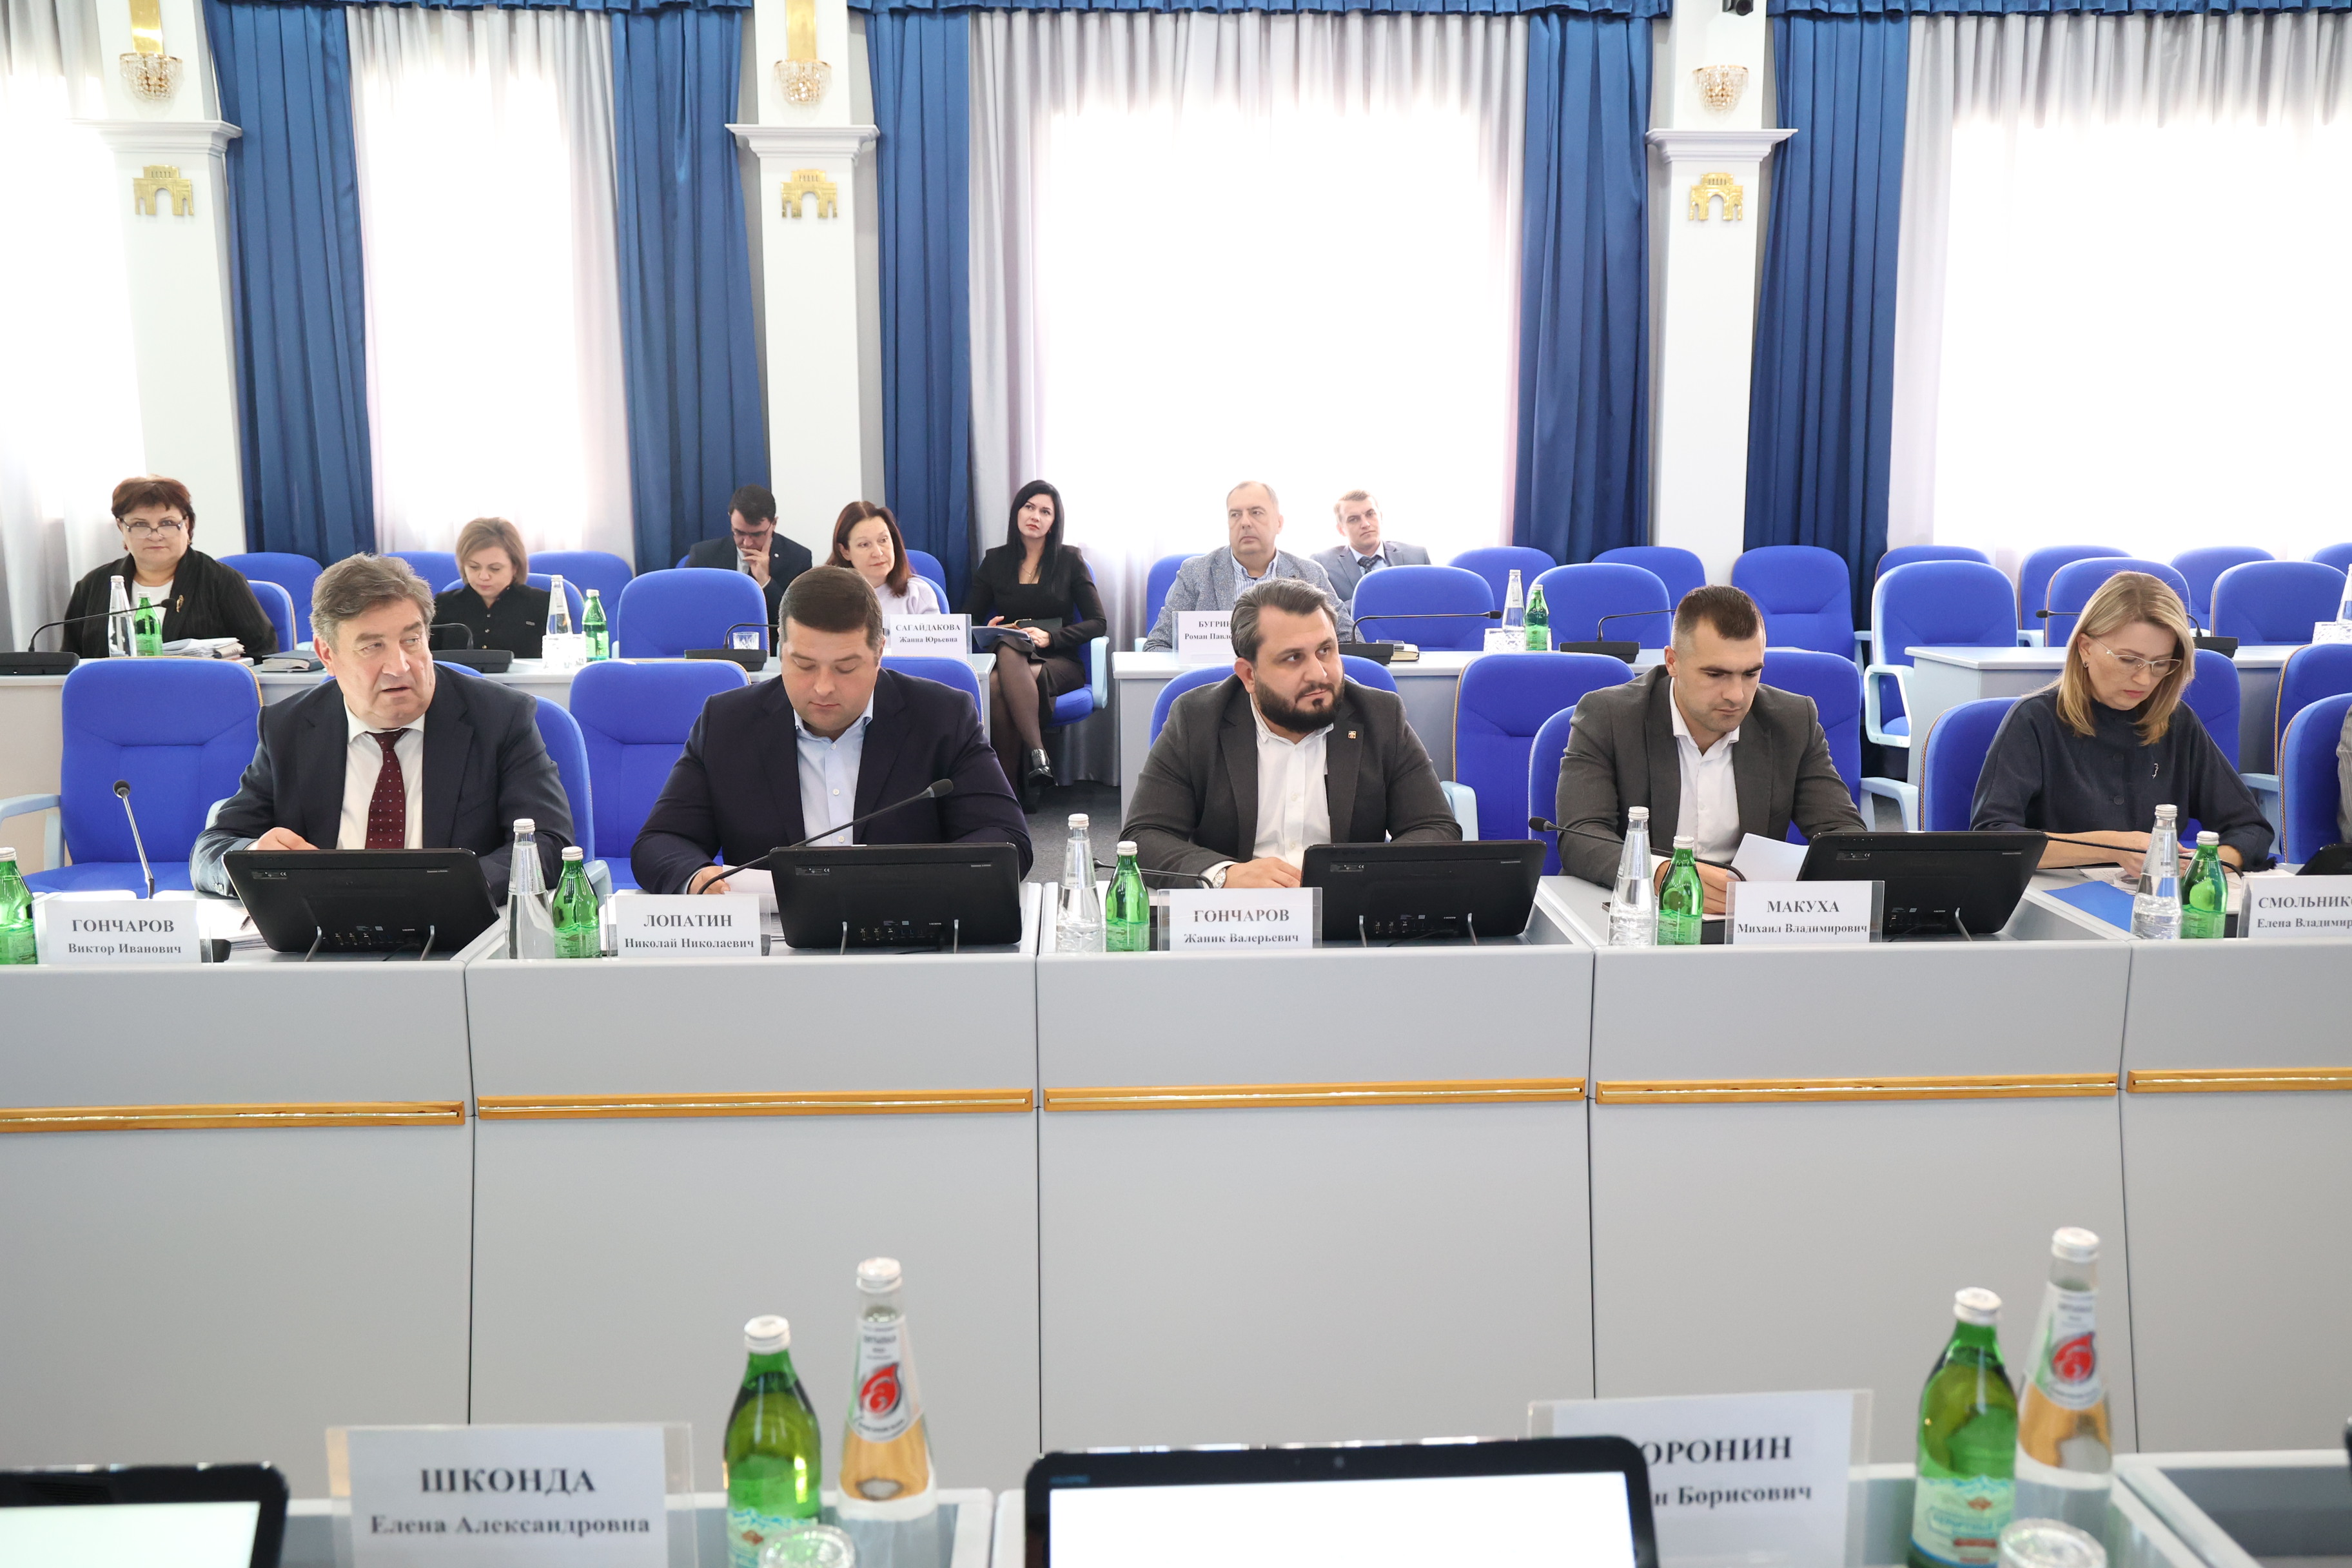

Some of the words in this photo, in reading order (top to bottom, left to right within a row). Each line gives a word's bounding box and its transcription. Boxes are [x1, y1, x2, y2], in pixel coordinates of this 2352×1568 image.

[896, 623, 961, 631] САГАЙДАКОВА
[1767, 900, 1840, 912] МАКУХА
[2258, 896, 2352, 908] СМОЛЬНИК
[643, 914, 732, 927] ЛОПАТИН
[1193, 909, 1290, 923] ГОНЧАРОВ
[72, 919, 175, 932] ГОНЧАРОВ
[1738, 924, 1781, 933] Михаил
[1785, 923, 1867, 935] Владимирович
[2257, 918, 2291, 928] Елена
[2295, 918, 2352, 929] Владимир
[625, 938, 677, 948] Николай
[681, 938, 754, 948] Николаевич
[1184, 934, 1226, 943] Жаник
[1230, 933, 1298, 945] Валерьевич
[68, 943, 115, 956] Виктор
[119, 943, 182, 954] Иванович
[1640, 1436, 1792, 1465] ОРОНИН
[420, 1467, 596, 1496] ШКОНДА
[1677, 1485, 1812, 1509] Борисович
[370, 1515, 447, 1534] Елена
[455, 1516, 651, 1538] Александровна
